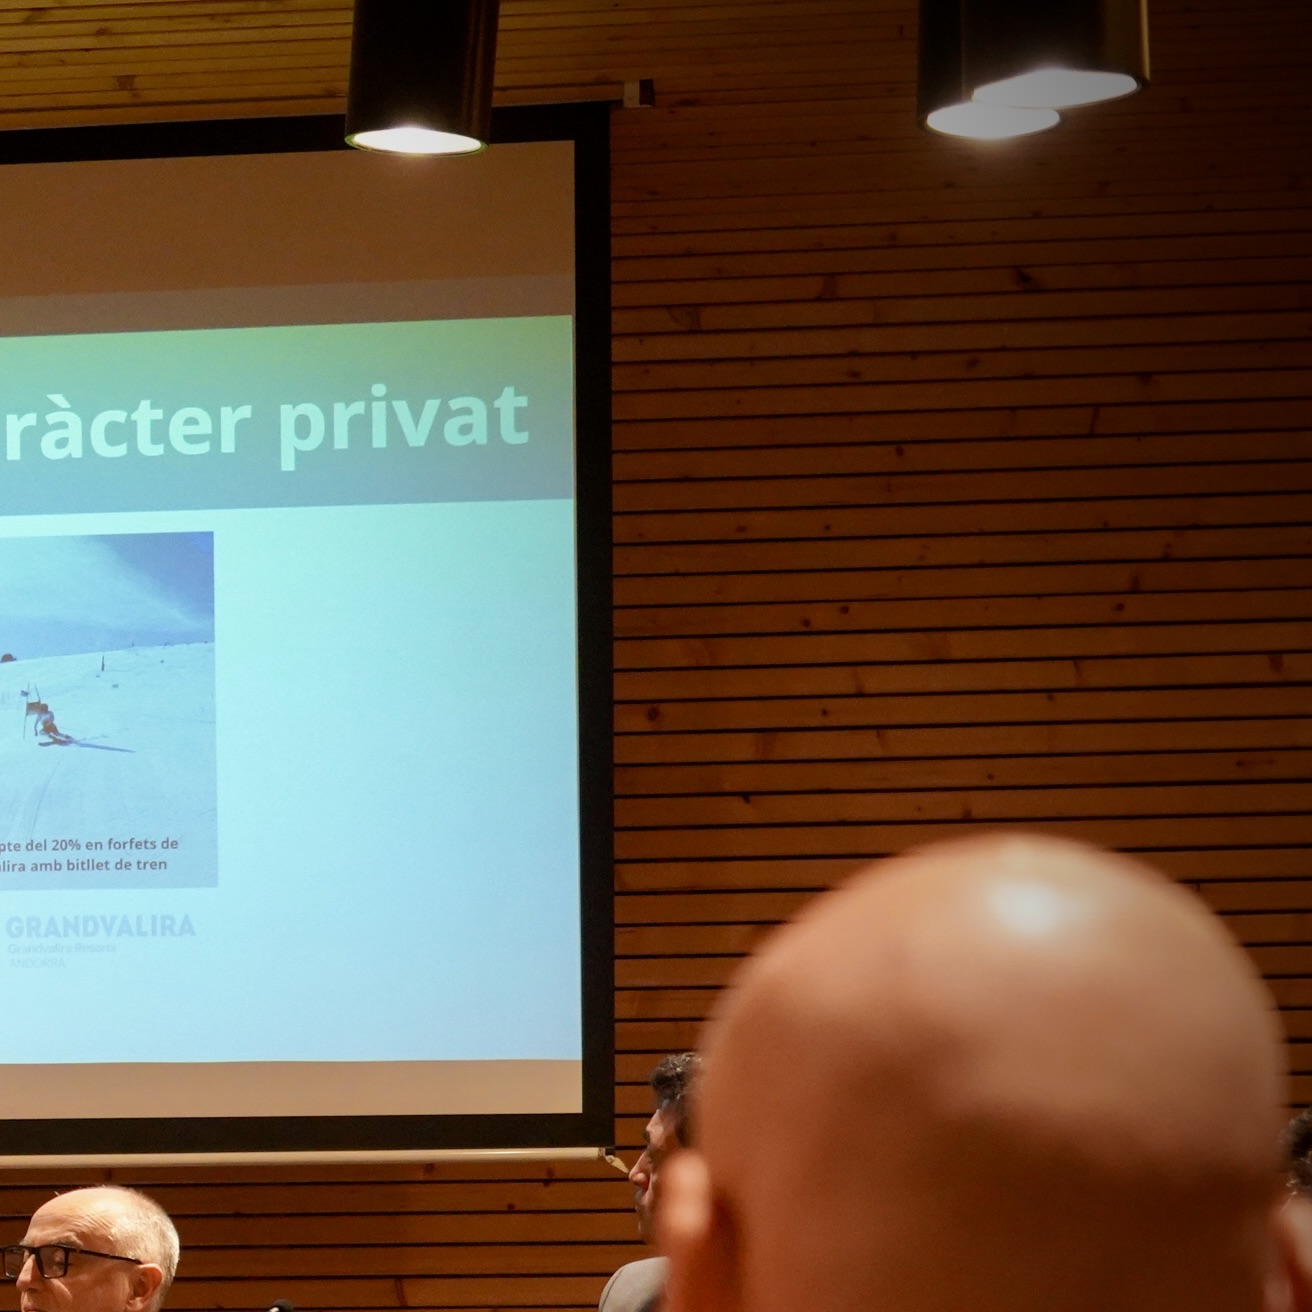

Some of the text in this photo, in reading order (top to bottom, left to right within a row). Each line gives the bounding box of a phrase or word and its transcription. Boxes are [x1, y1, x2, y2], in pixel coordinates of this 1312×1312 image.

[279, 383, 529, 472] privat
[26, 839, 48, 851] del
[51, 839, 81, 851] 20%
[85, 840, 104, 850] en
[108, 838, 157, 850] forfets
[161, 838, 179, 849] de
[30, 859, 62, 872] amb
[66, 859, 110, 871] bitllet
[114, 859, 132, 870] de
[136, 860, 167, 870] tren
[5, 914, 196, 939] GRANDVALIRA
